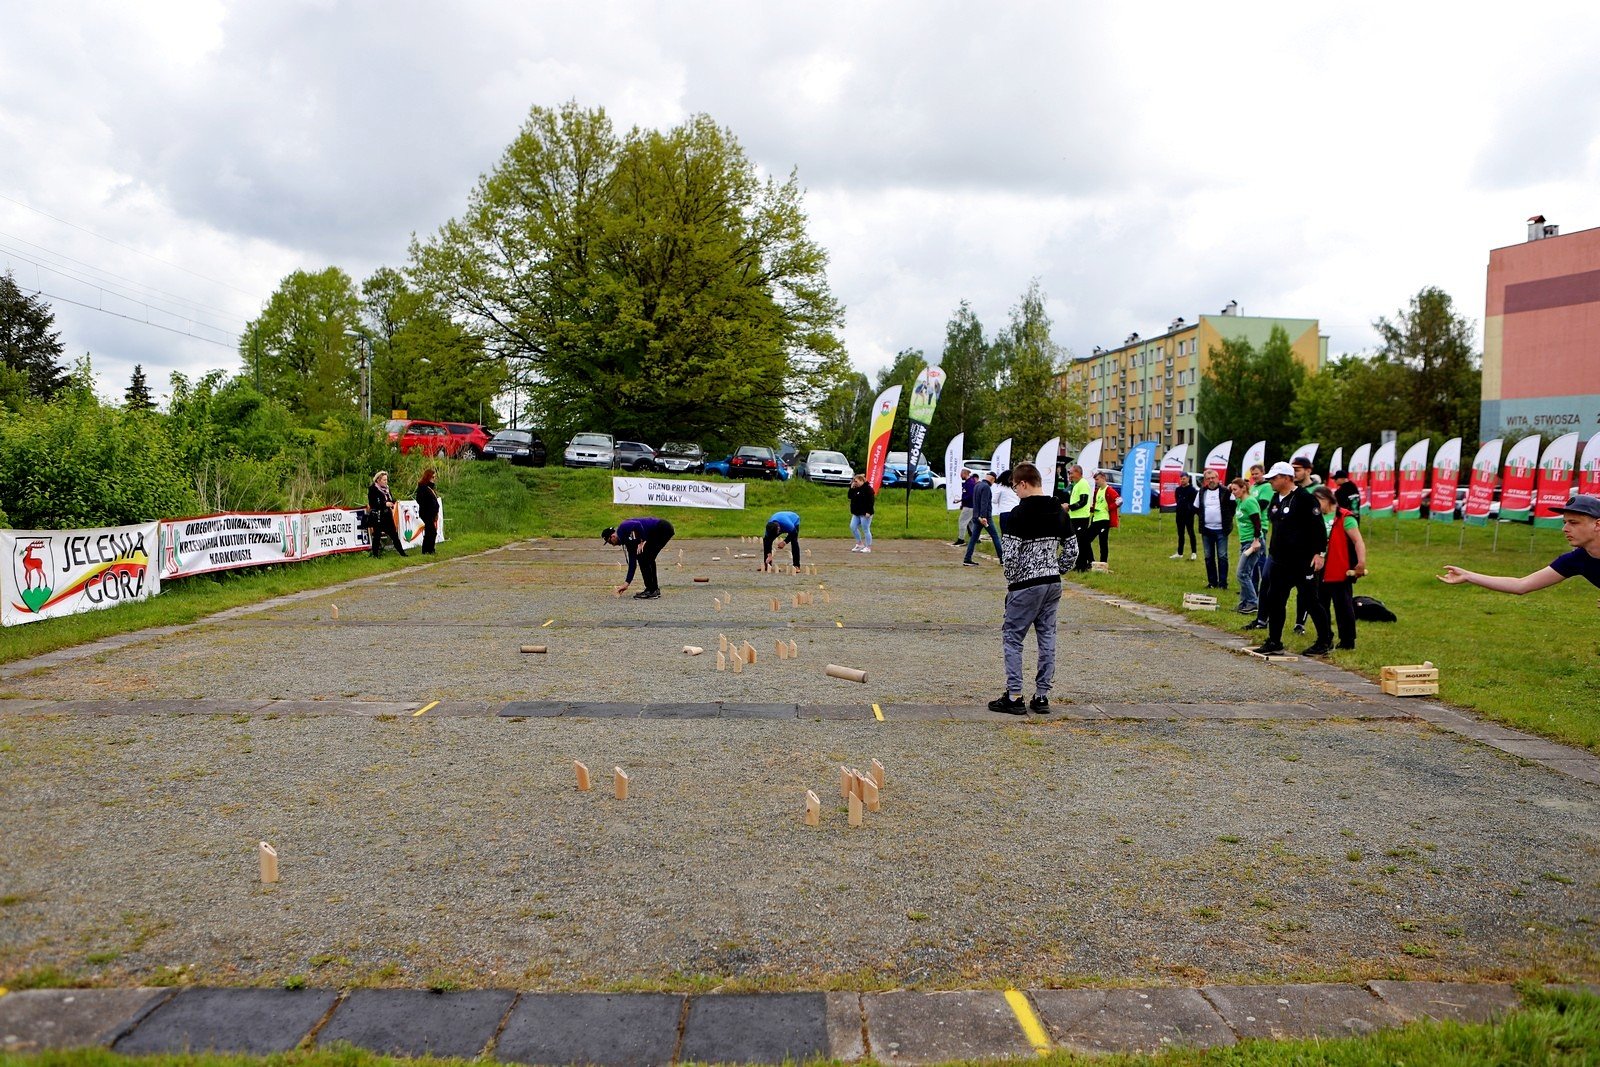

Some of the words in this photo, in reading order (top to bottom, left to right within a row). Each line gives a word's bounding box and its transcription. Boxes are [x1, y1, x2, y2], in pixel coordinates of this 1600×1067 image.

[1506, 416, 1528, 426] WITA
[1534, 414, 1580, 426] STWOSZA
[910, 426, 927, 466] MÖLKKY
[648, 482, 670, 492] GRAND
[672, 483, 687, 492] PRIX
[688, 484, 712, 493] POLSKI
[1132, 448, 1147, 514] DECATHLON
[219, 534, 247, 547] KULTURY
[248, 532, 281, 544] FIZYCZNEJ
[320, 538, 333, 548] PRZY
[62, 531, 148, 572] JELENIA
[209, 549, 252, 564] KARKONOSZE
[85, 564, 145, 604] GÓRA
